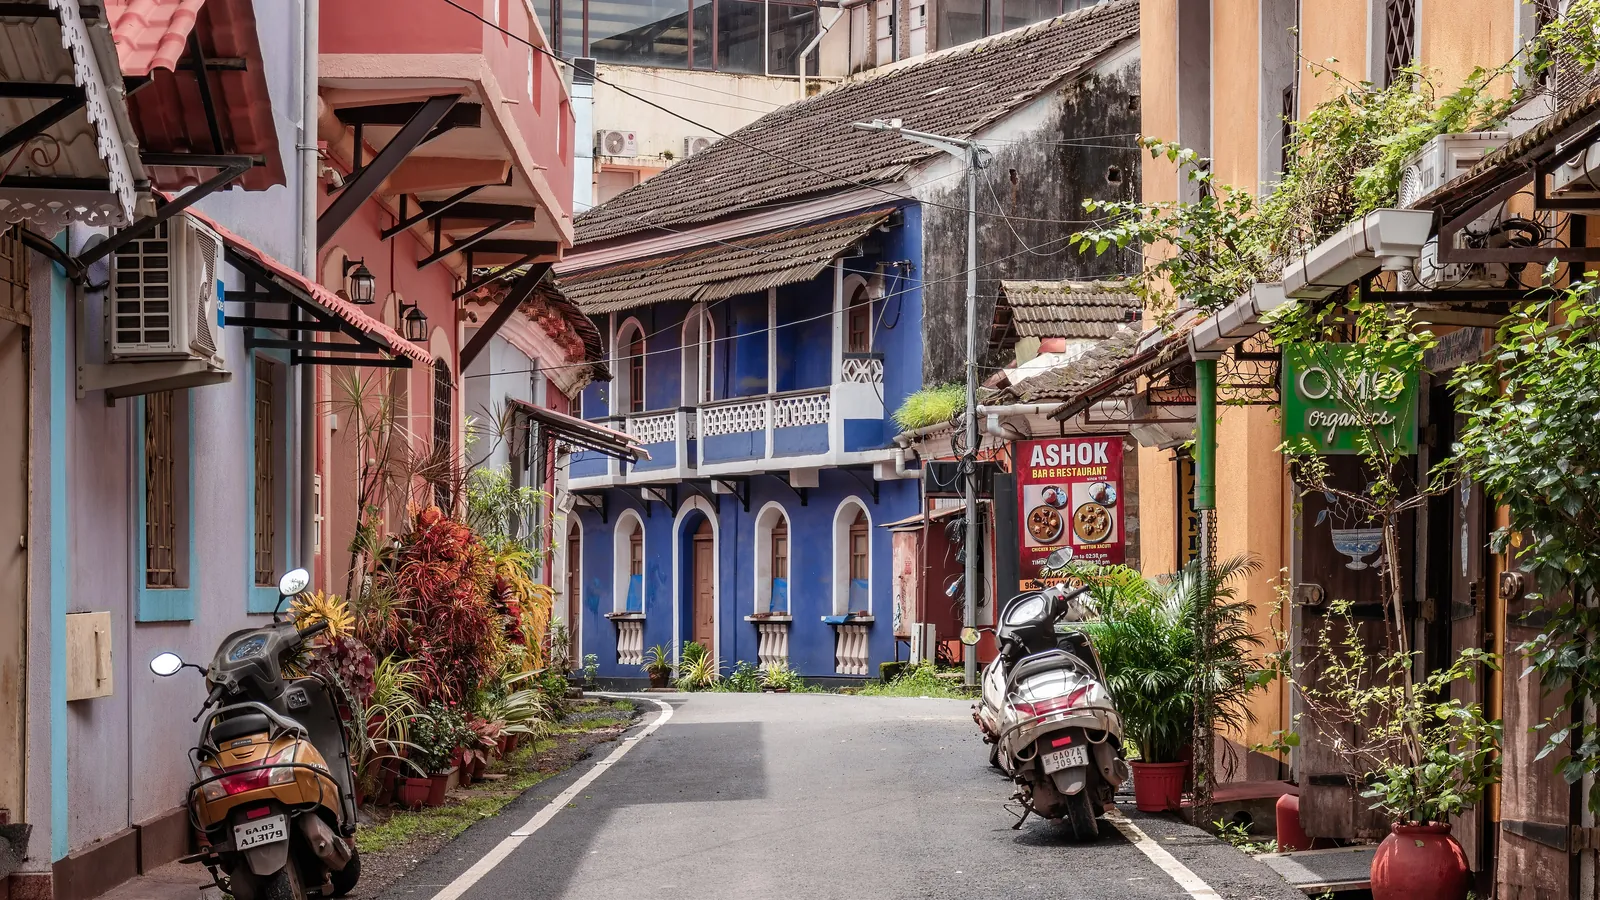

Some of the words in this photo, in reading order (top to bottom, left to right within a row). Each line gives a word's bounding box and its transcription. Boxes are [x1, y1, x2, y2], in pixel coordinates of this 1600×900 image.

[1308, 410, 1396, 443] organcs
[1030, 441, 1109, 467] ASHOK
[1032, 469, 1048, 479] BAR
[1049, 468, 1056, 478] &
[1056, 466, 1107, 478] RESTAURANT
[240, 829, 283, 847] AJ.3179
[245, 823, 275, 836] GA.03
